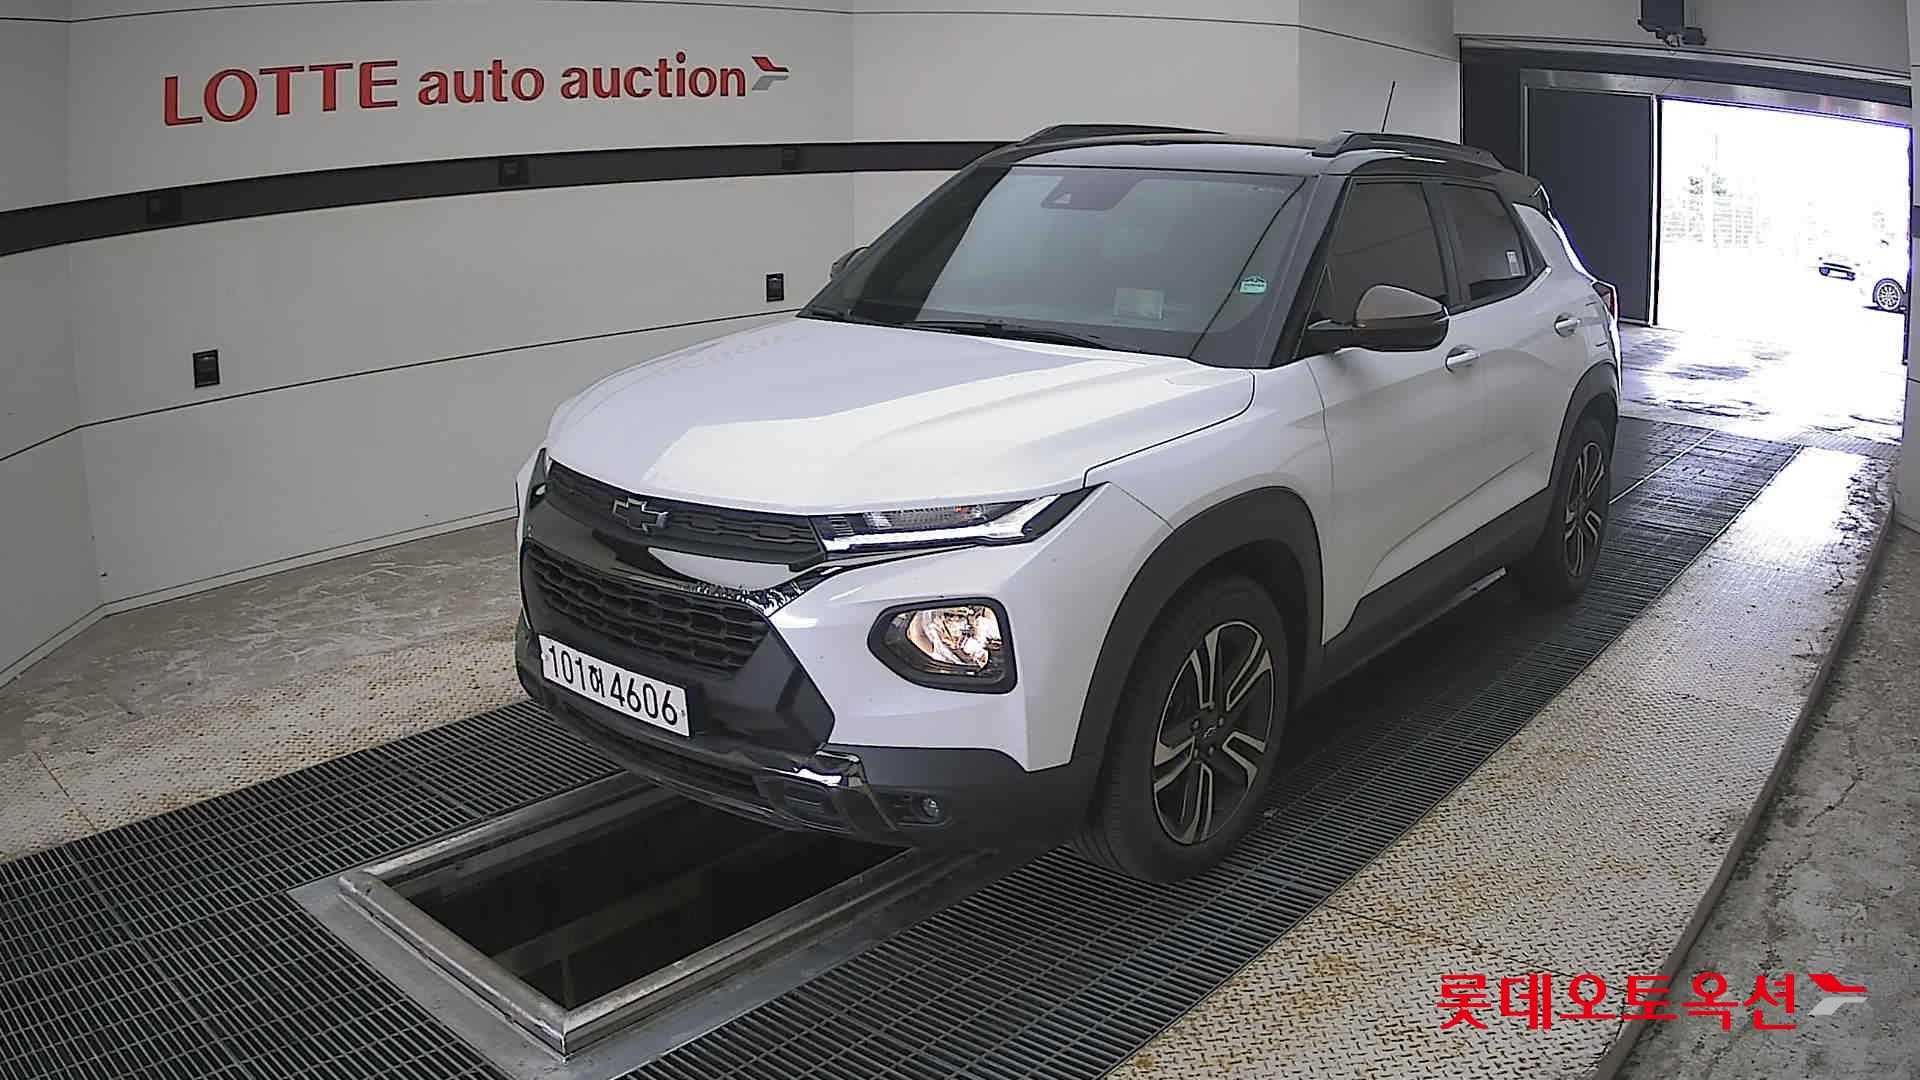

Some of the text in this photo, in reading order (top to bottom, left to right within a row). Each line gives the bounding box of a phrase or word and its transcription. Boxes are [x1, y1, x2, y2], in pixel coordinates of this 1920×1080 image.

[163, 51, 747, 126] LOTTE auto auction
[549, 645, 678, 726] 101허4606
